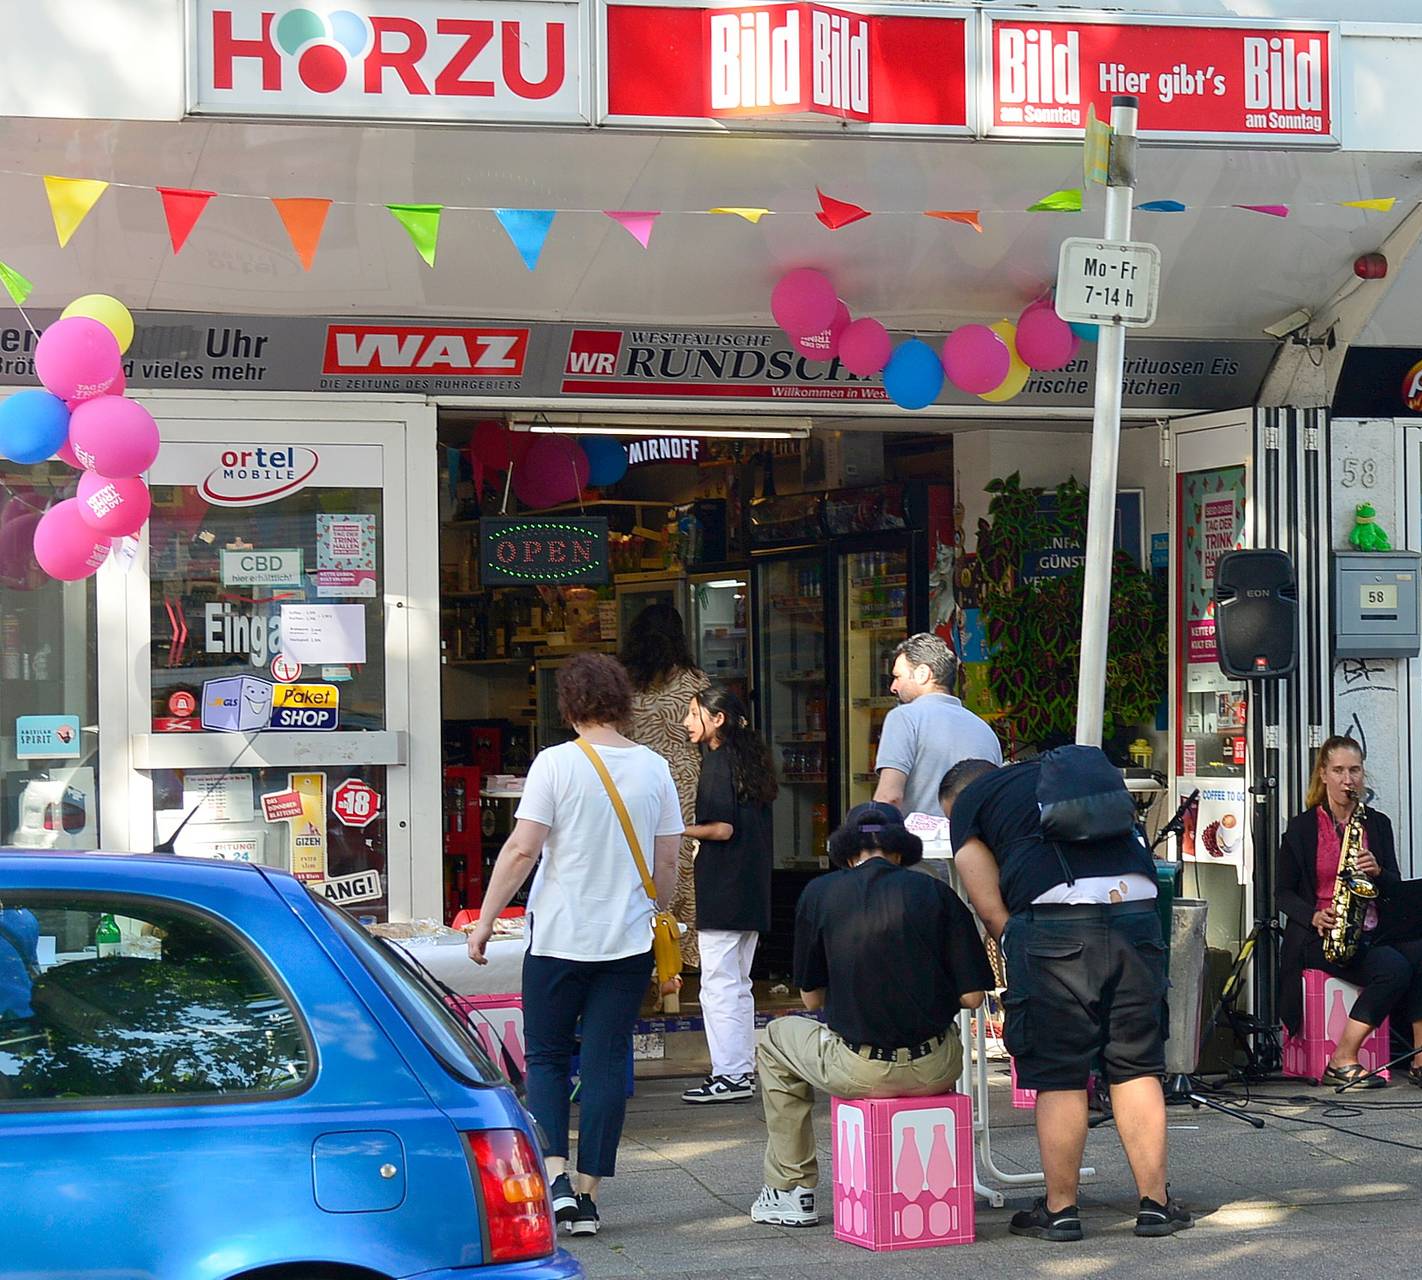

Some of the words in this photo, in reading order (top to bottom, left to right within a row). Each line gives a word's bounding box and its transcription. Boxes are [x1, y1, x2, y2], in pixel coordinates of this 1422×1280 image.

[710, 9, 801, 110] Bild
[812, 10, 869, 114] Bild
[998, 28, 1081, 105] Bild
[1099, 63, 1151, 94] Hier
[1157, 64, 1227, 104] gibt's
[1243, 36, 1323, 112] Bild
[1000, 109, 1024, 122] am
[1024, 105, 1081, 126] Sonntag
[1245, 114, 1268, 128] am
[1269, 112, 1323, 132] Sonntag
[1125, 289, 1134, 308] h
[205, 328, 269, 359] Uhr
[631, 330, 772, 348] WESTFÄLISCHE
[335, 333, 519, 369] WAZ
[141, 360, 205, 381] vieles
[211, 361, 267, 381] mehr
[570, 351, 615, 376] WR
[1210, 358, 1239, 376] Eis
[320, 378, 341, 389] DIE
[347, 379, 400, 390] ZEITUNG
[406, 379, 430, 390] DES
[435, 379, 522, 391] RUHRGEBIETS
[771, 386, 846, 400] Willkommen
[847, 387, 858, 399] in
[220, 447, 294, 468] ortel
[624, 437, 700, 465] MIRNOFF
[223, 469, 295, 480] MOBILE
[1341, 457, 1377, 489] 58
[1206, 520, 1218, 531] TAG
[1219, 518, 1233, 530] DER
[1205, 533, 1233, 550] TRINK
[496, 540, 593, 564] OPEN
[240, 555, 284, 572] CBD
[231, 574, 249, 582] hier
[1246, 589, 1270, 598] EON
[1368, 591, 1385, 603] 58
[223, 697, 239, 707] GLS
[284, 688, 331, 705] Paket
[280, 710, 330, 727] SHOP
[21, 735, 52, 744] SPIRIT
[343, 790, 370, 816] 18
[1202, 789, 1226, 801] COFFEE
[1227, 791, 1236, 802] TO
[295, 837, 321, 847] GIZEH
[324, 876, 374, 900] ANG!
